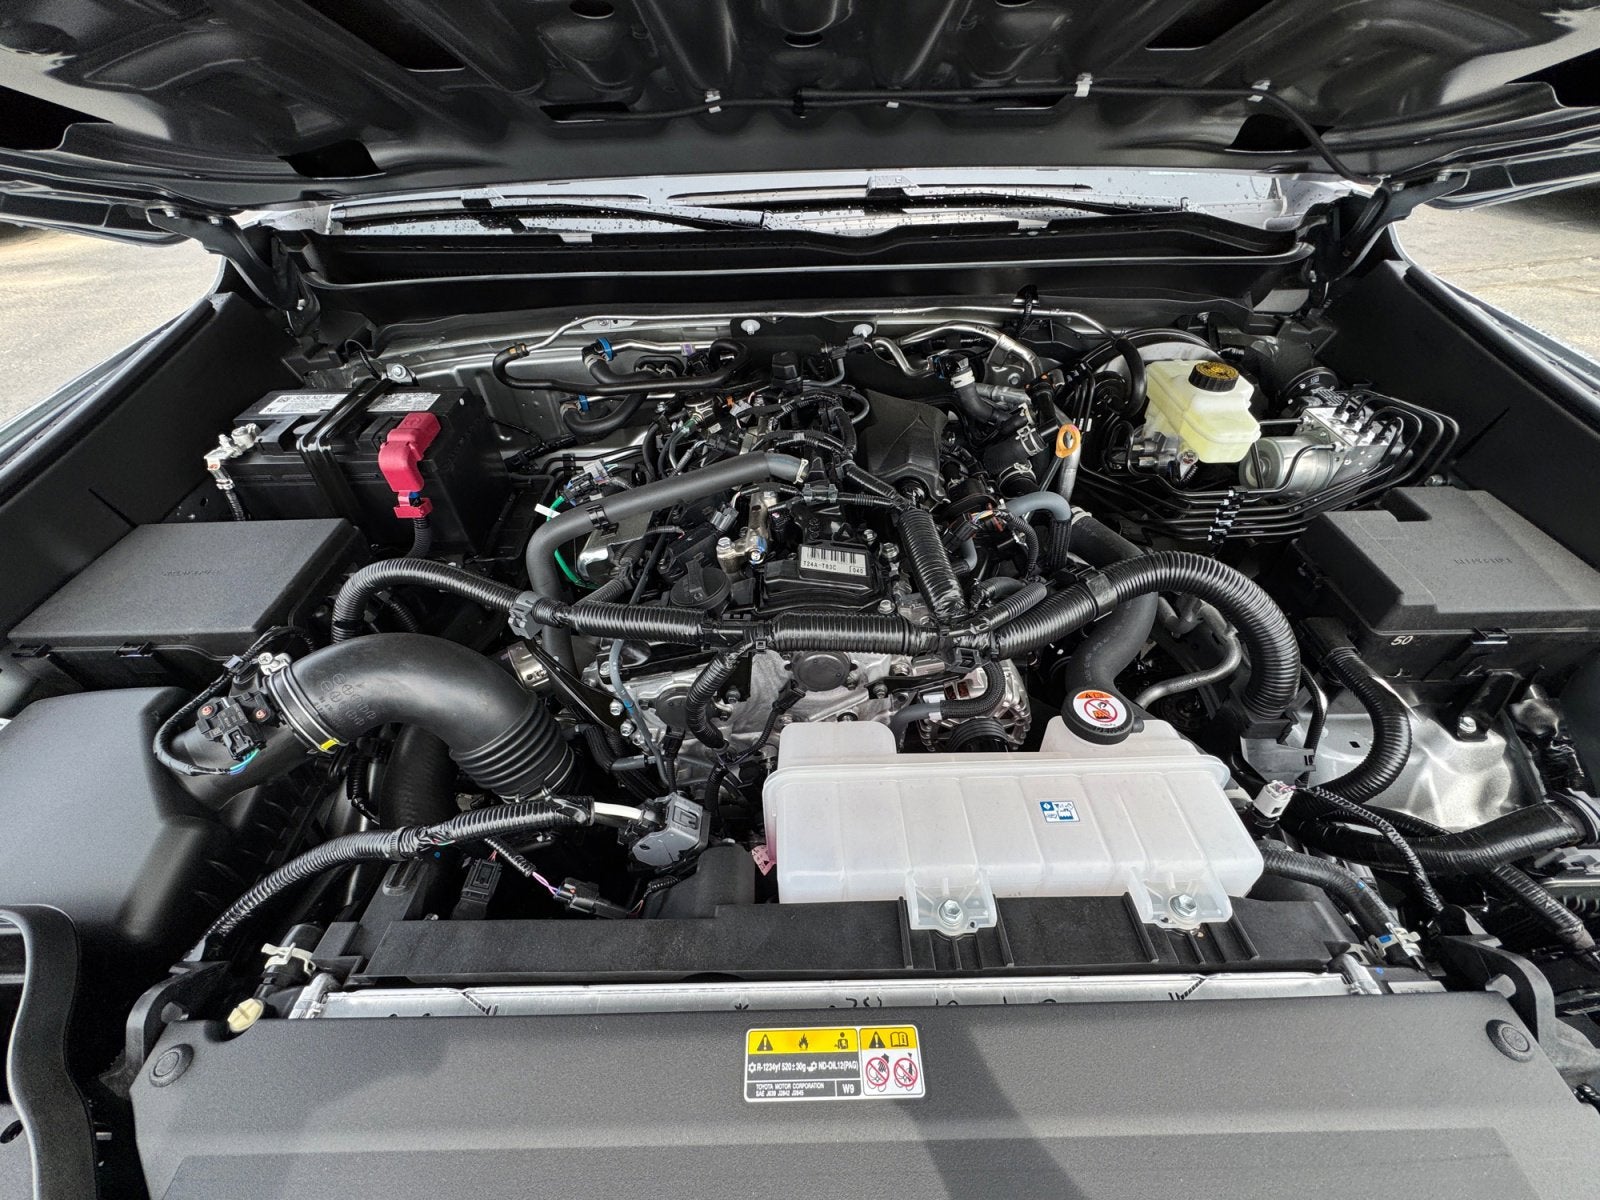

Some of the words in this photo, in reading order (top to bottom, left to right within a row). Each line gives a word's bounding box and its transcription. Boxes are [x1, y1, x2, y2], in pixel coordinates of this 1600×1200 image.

[1391, 635, 1413, 646] 50
[792, 1082, 825, 1090] CORPORATION
[842, 1083, 855, 1095] W9
